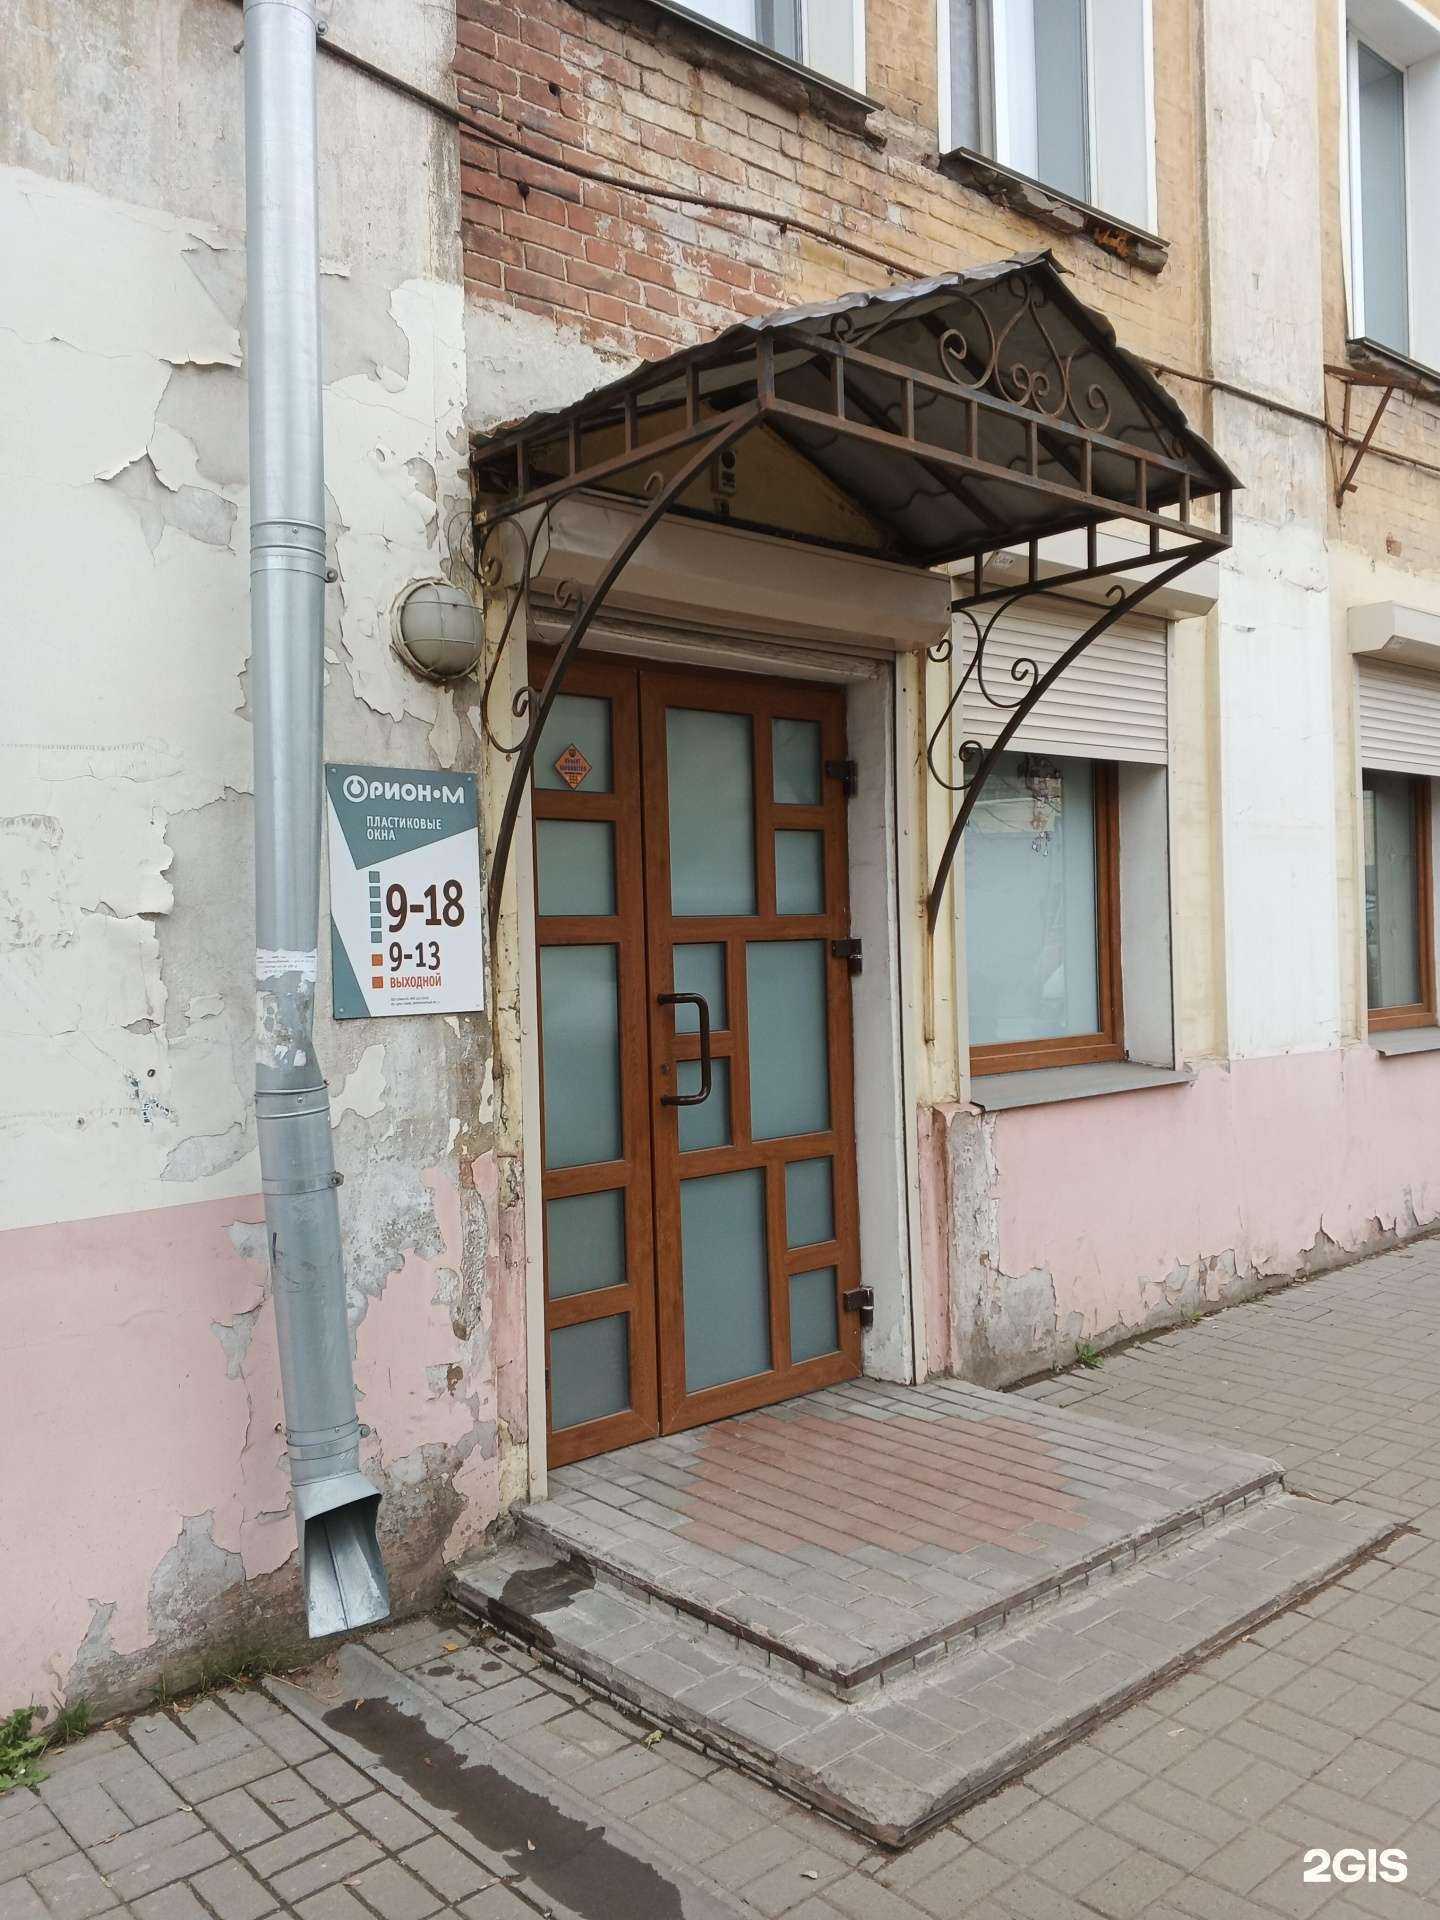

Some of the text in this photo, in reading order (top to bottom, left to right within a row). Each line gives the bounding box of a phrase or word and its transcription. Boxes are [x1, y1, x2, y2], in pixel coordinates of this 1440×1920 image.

[366, 815, 443, 830] ПЛАСТИКОВЫЕ
[366, 829, 396, 841] ОКНА
[386, 879, 465, 933] 9-18
[389, 941, 441, 972] 9-13
[390, 973, 442, 989] ВЫХОДНОЙ
